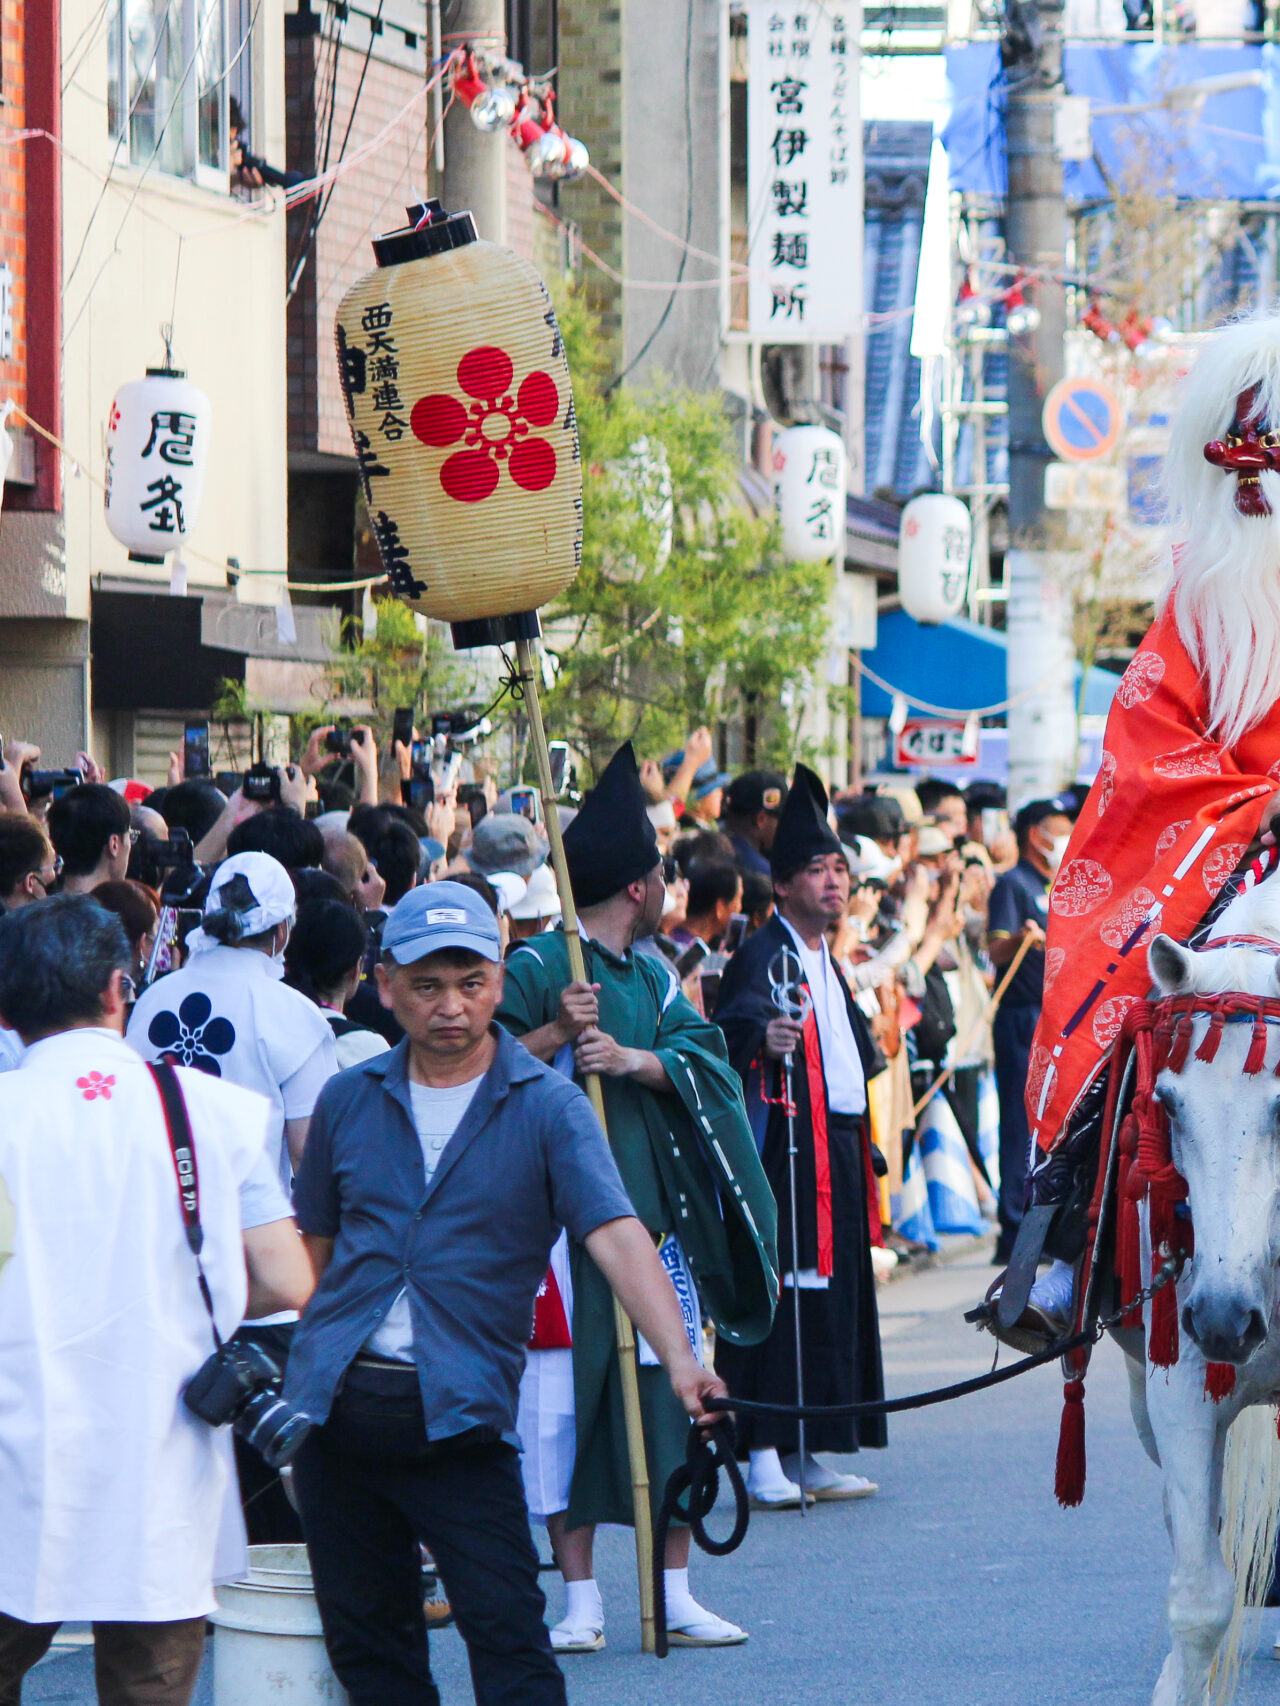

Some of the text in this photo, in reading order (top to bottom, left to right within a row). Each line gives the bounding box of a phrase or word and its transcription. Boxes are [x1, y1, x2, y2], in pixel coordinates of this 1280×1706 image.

[769, 75, 809, 321] 宮伊製麺所
[361, 302, 409, 441] 西天満連合
